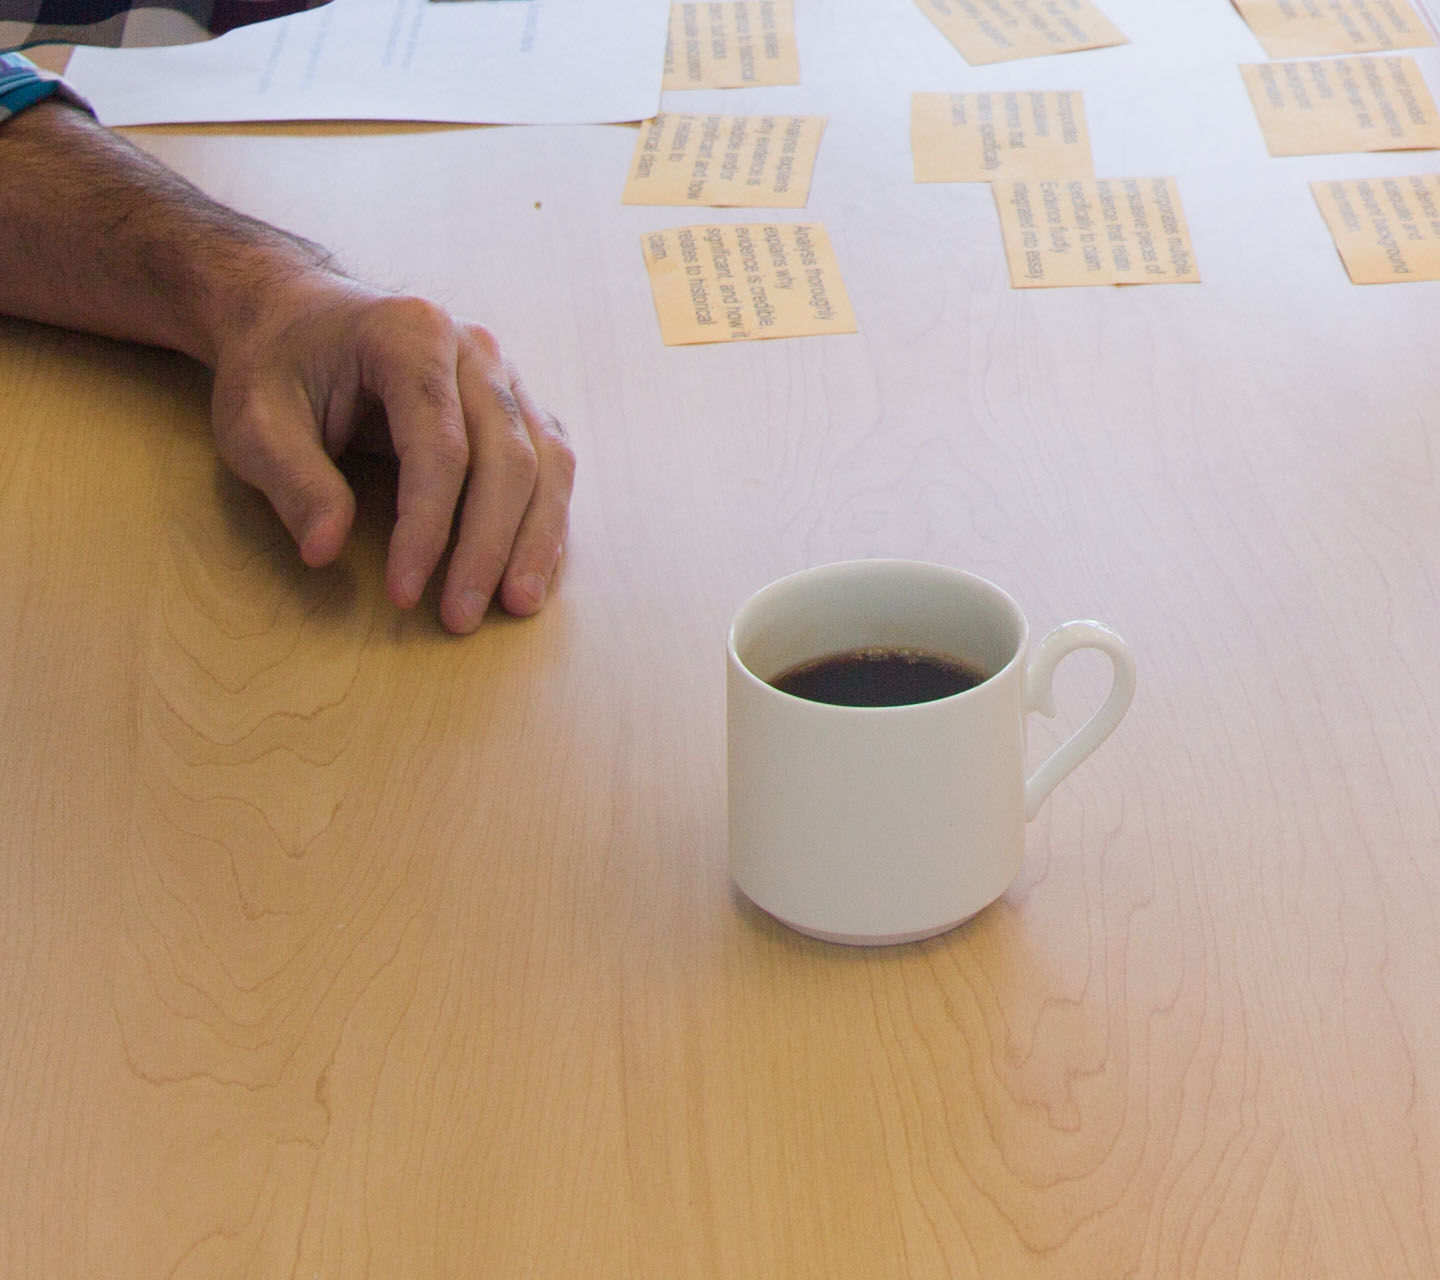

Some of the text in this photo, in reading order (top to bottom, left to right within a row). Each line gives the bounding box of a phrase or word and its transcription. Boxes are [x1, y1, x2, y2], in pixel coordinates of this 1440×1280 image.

[668, 152, 686, 162] to
[671, 122, 692, 151] relates
[746, 118, 776, 186] why evidence is
[773, 118, 805, 193] Analysis explains
[687, 180, 709, 200] how
[691, 160, 709, 178] and
[1010, 182, 1035, 228] integrated
[1040, 182, 1072, 254] Evidence fluidly
[1066, 181, 1097, 230] specifically
[1096, 181, 1119, 221] evidence
[1152, 178, 1180, 235] Incorporates
[1383, 180, 1426, 240] adequate and
[1410, 177, 1440, 218] evidence
[1022, 230, 1040, 248] into
[1079, 233, 1098, 243] to
[1106, 224, 1128, 242] that
[1123, 180, 1166, 274] persuasive pieces of
[1357, 182, 1413, 274] relevant background
[678, 230, 718, 325] relates to historical
[735, 227, 759, 272] evidence
[747, 274, 766, 284] is
[763, 226, 795, 290] explains why
[792, 225, 838, 320] Analysis thoroughly
[719, 284, 740, 304] and
[726, 306, 745, 329] how
[730, 330, 751, 338] it
